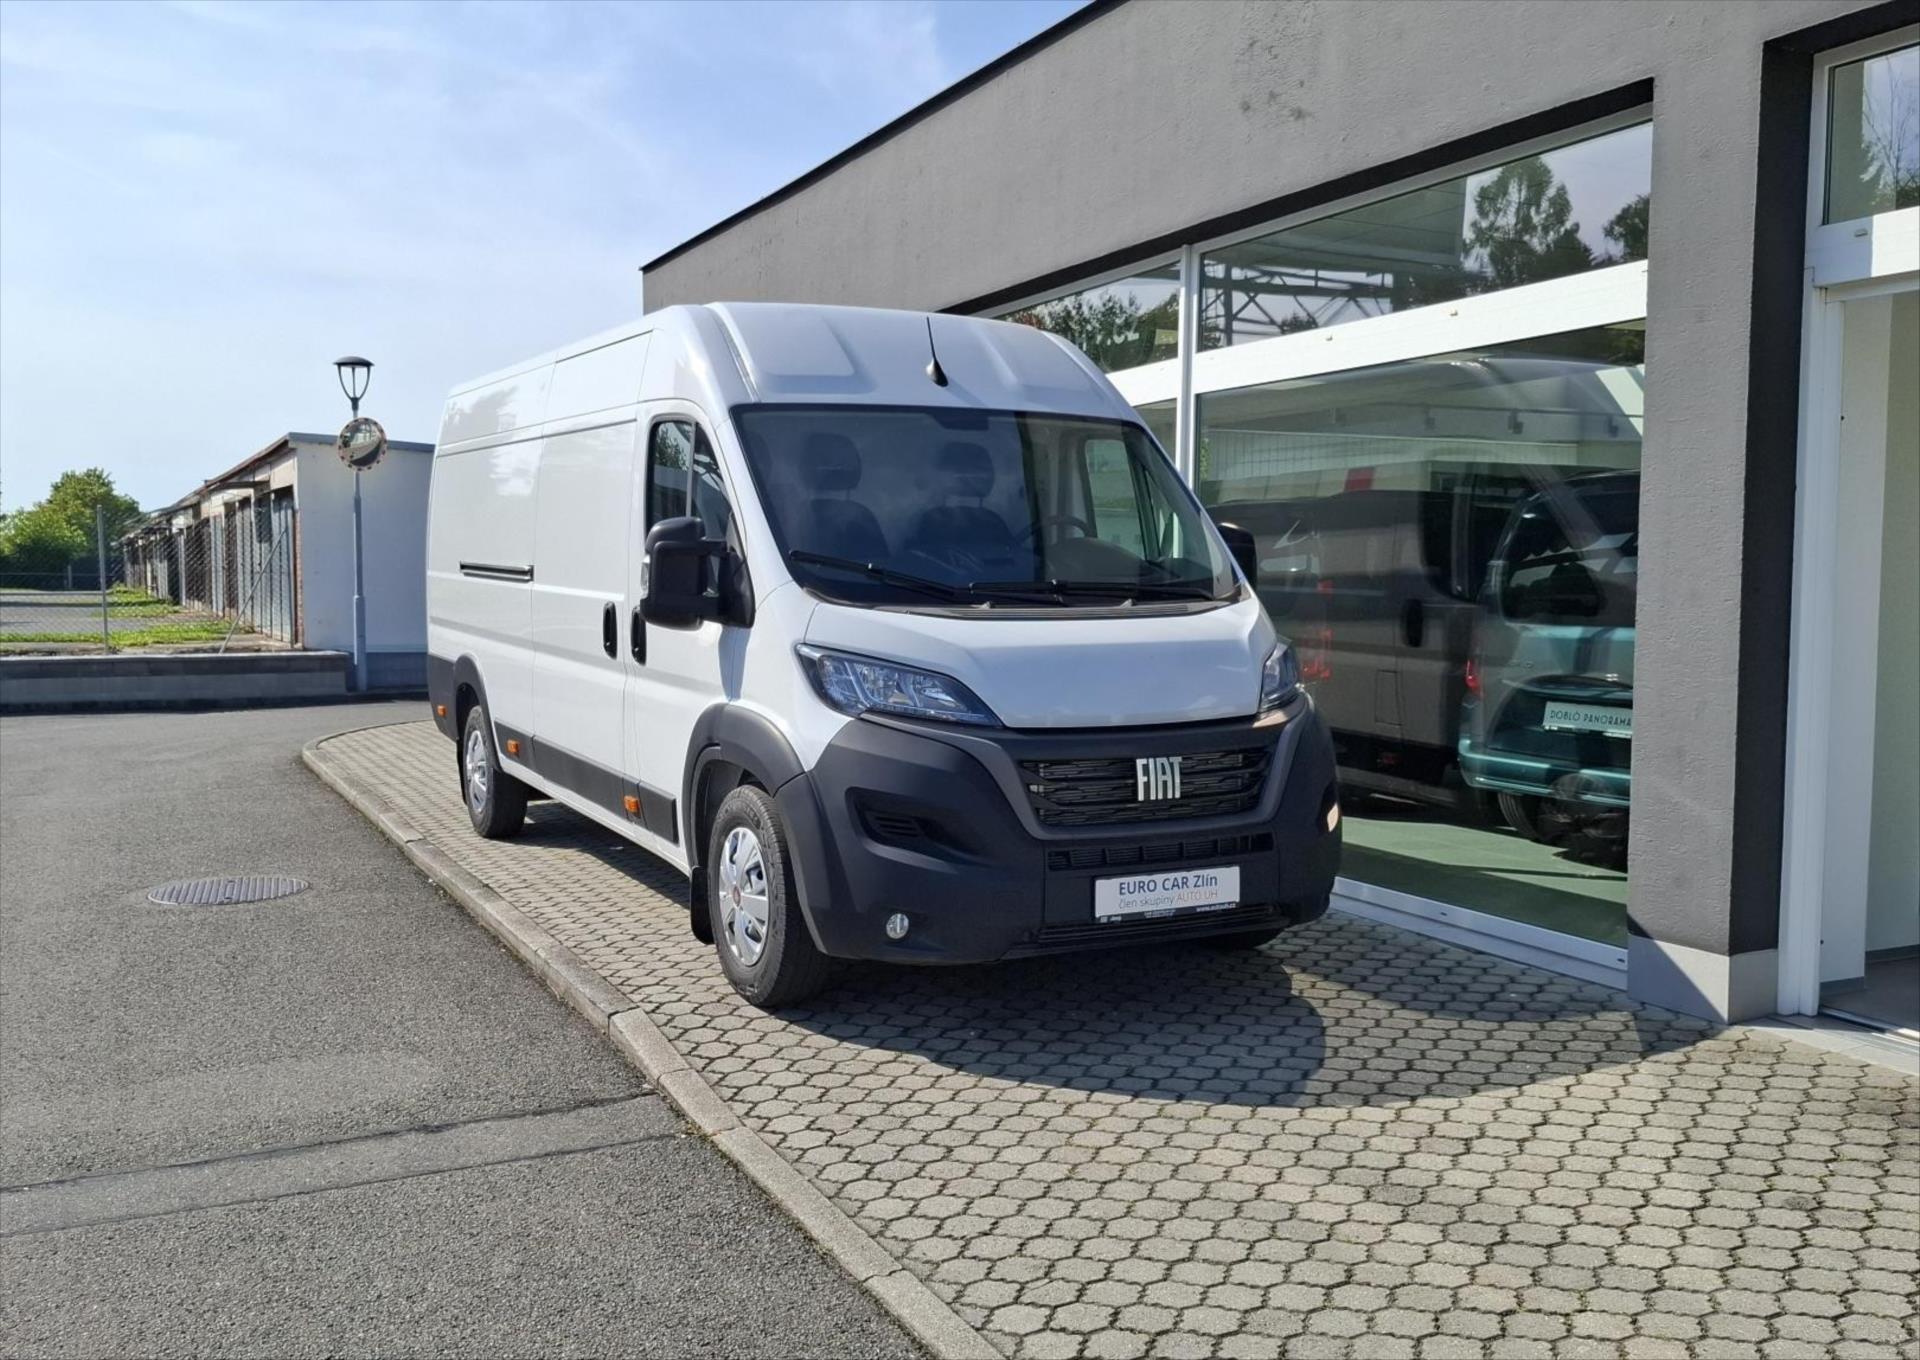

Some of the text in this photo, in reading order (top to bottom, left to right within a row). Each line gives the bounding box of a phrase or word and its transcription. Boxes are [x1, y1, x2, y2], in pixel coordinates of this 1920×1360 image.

[1583, 713, 1632, 726] PANORAMA
[1136, 756, 1182, 801] FIAT
[1119, 873, 1217, 895] EURO CAR Zlín
[1140, 894, 1173, 908] skupiny
[1177, 891, 1201, 901] AUTO
[1205, 889, 1218, 899] UH
